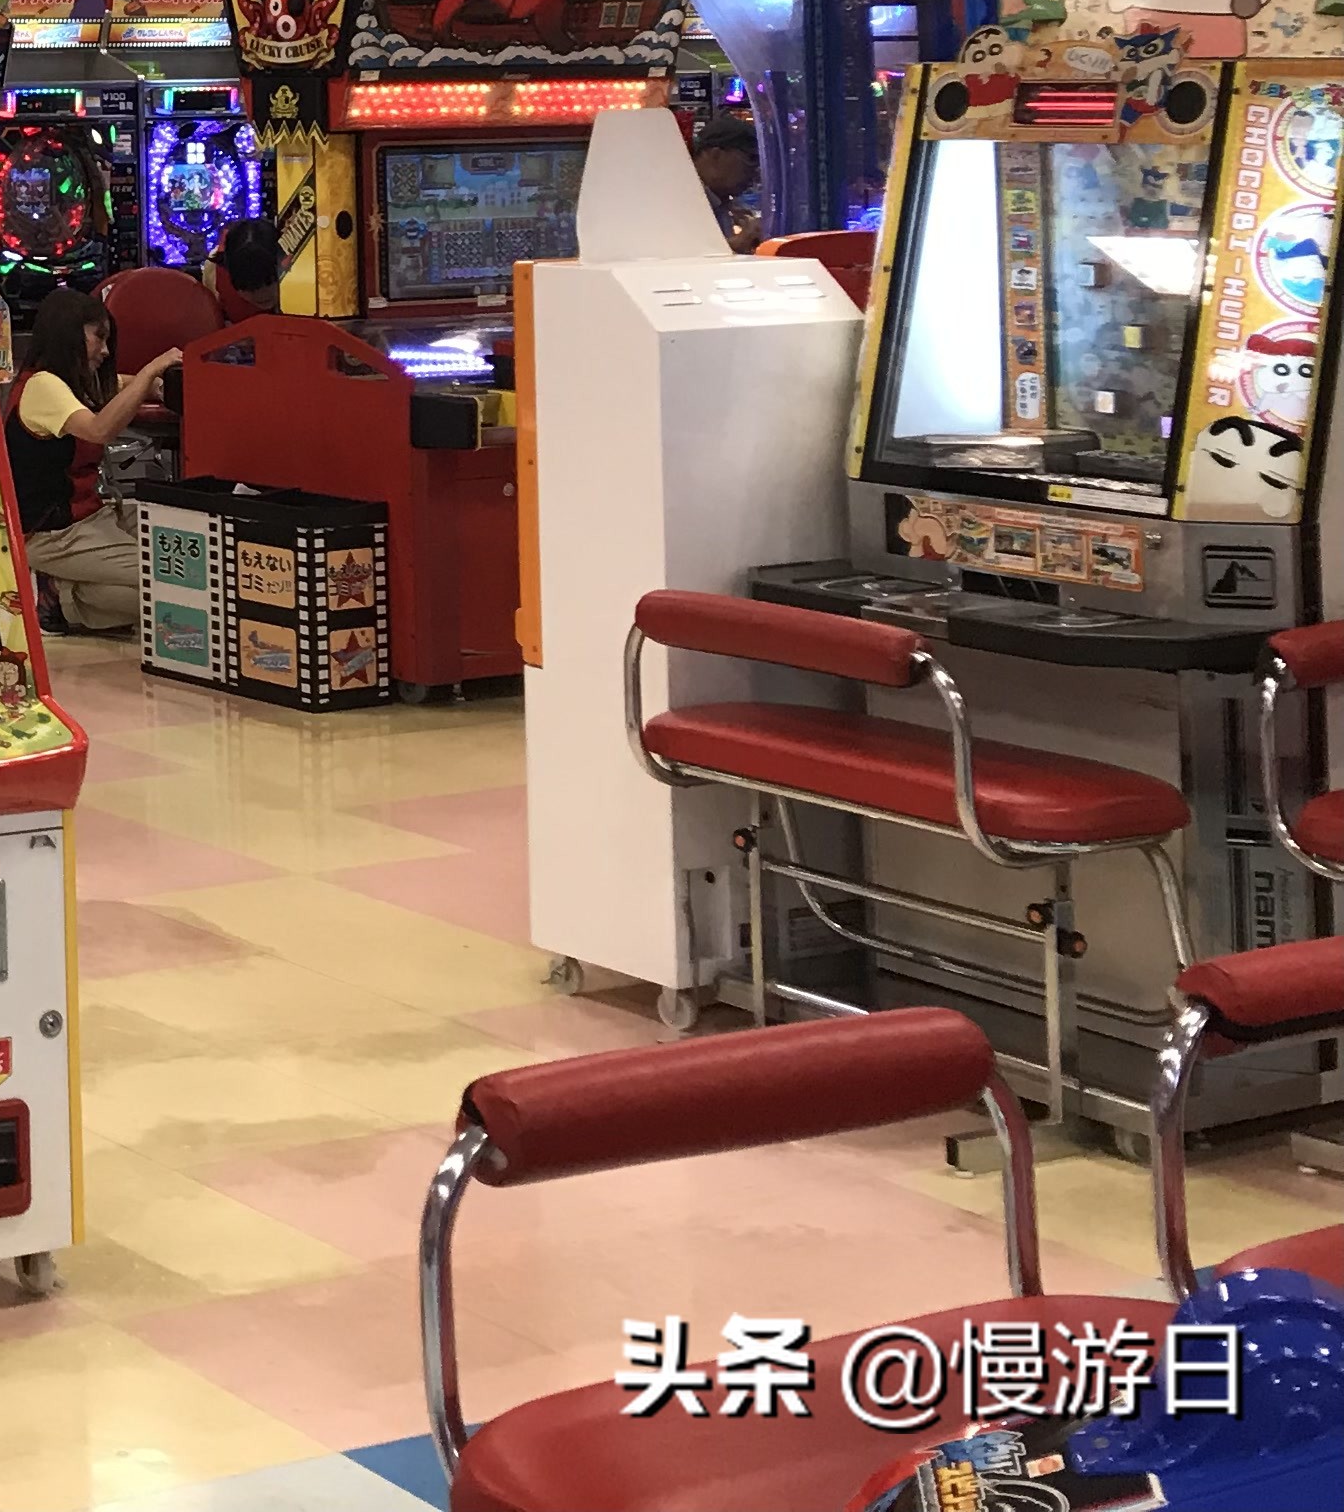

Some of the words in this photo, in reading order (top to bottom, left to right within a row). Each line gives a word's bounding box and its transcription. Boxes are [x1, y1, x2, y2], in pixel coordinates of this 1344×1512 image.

[249, 37, 282, 58] LUCKY
[157, 532, 201, 559] もえる
[158, 556, 186, 580] ゴミ
[240, 549, 292, 574] もえない
